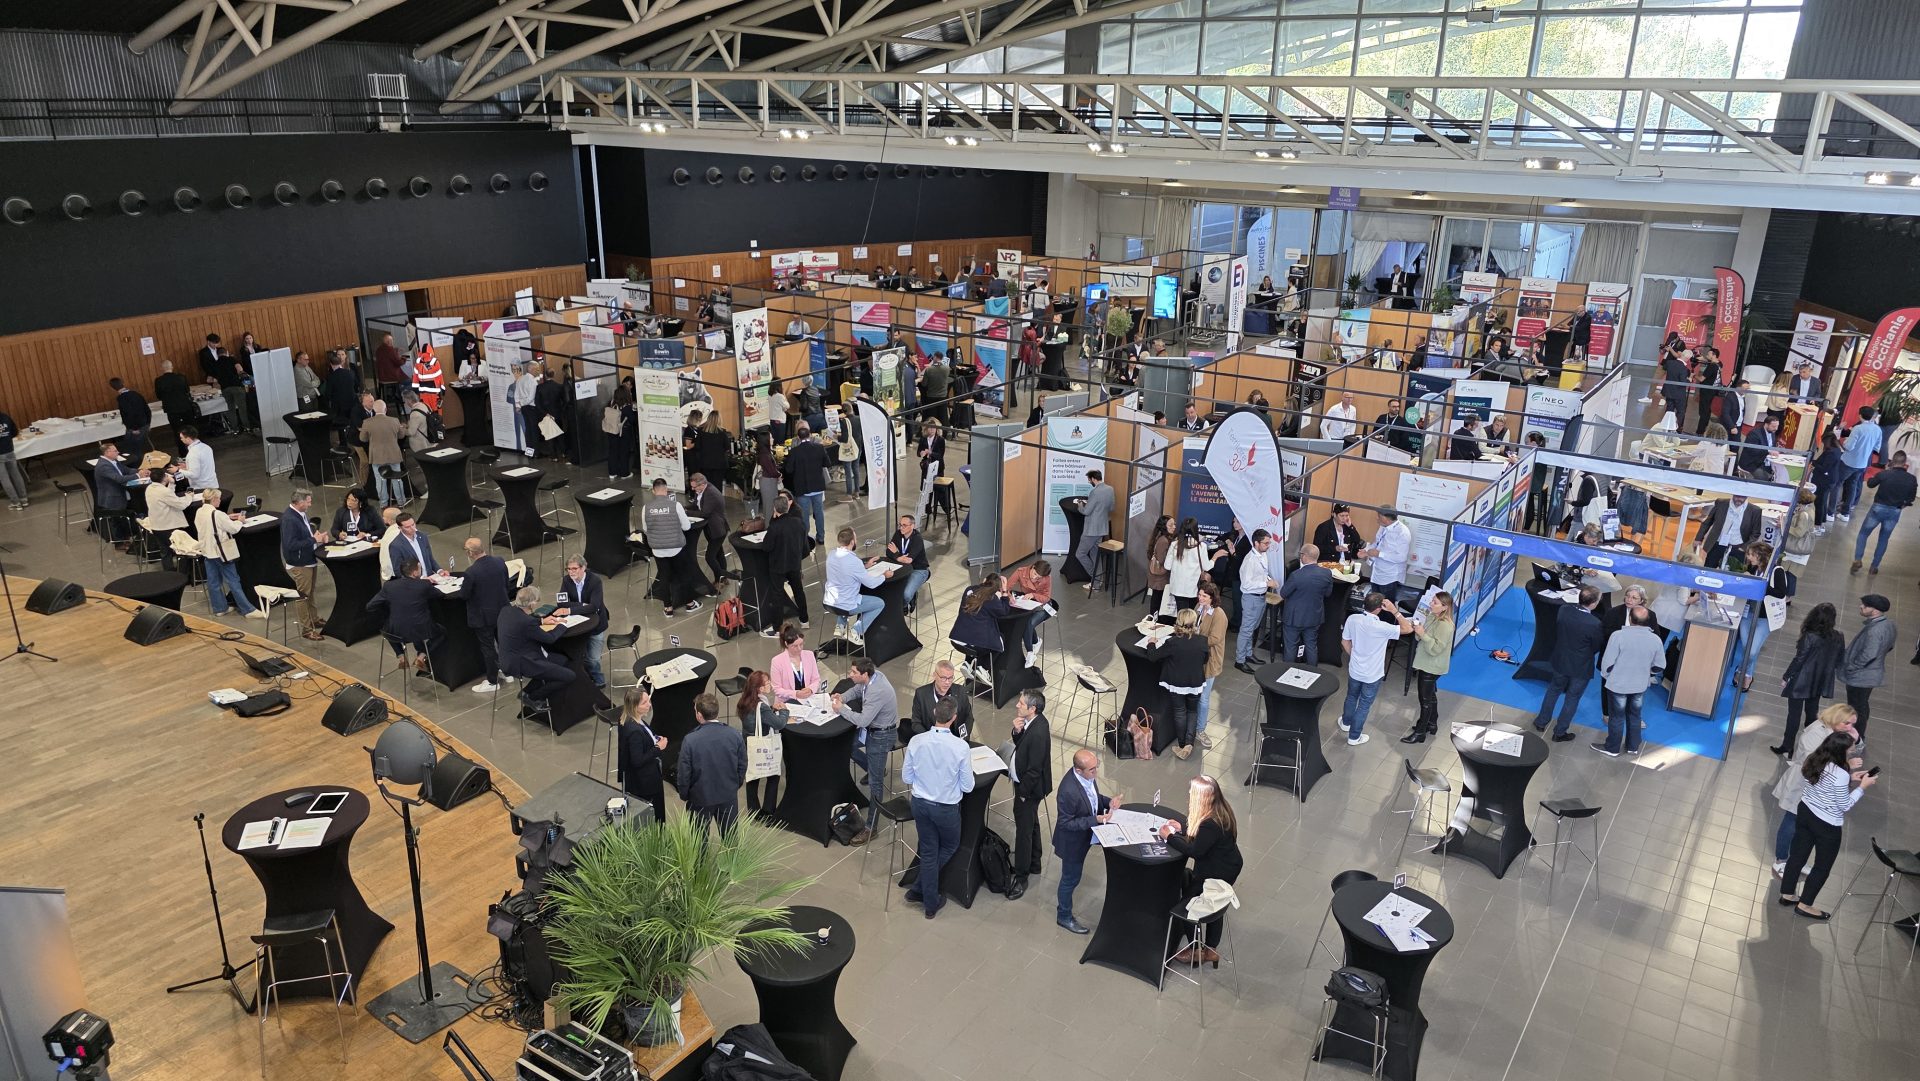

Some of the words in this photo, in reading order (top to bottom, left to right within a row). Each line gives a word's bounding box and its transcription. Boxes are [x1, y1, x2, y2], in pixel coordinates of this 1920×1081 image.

[1258, 235, 1266, 272] PISCINES
[1111, 271, 1140, 288] MSI
[1868, 336, 1881, 359] Région
[1872, 315, 1906, 371] Occitanie
[1865, 358, 1872, 368] La
[1541, 396, 1564, 405] INEO
[1229, 453, 1242, 472] 30
[1199, 497, 1229, 505] NUCLÉAI
[649, 506, 670, 514] ORAPI
[1396, 877, 1404, 885] A1
